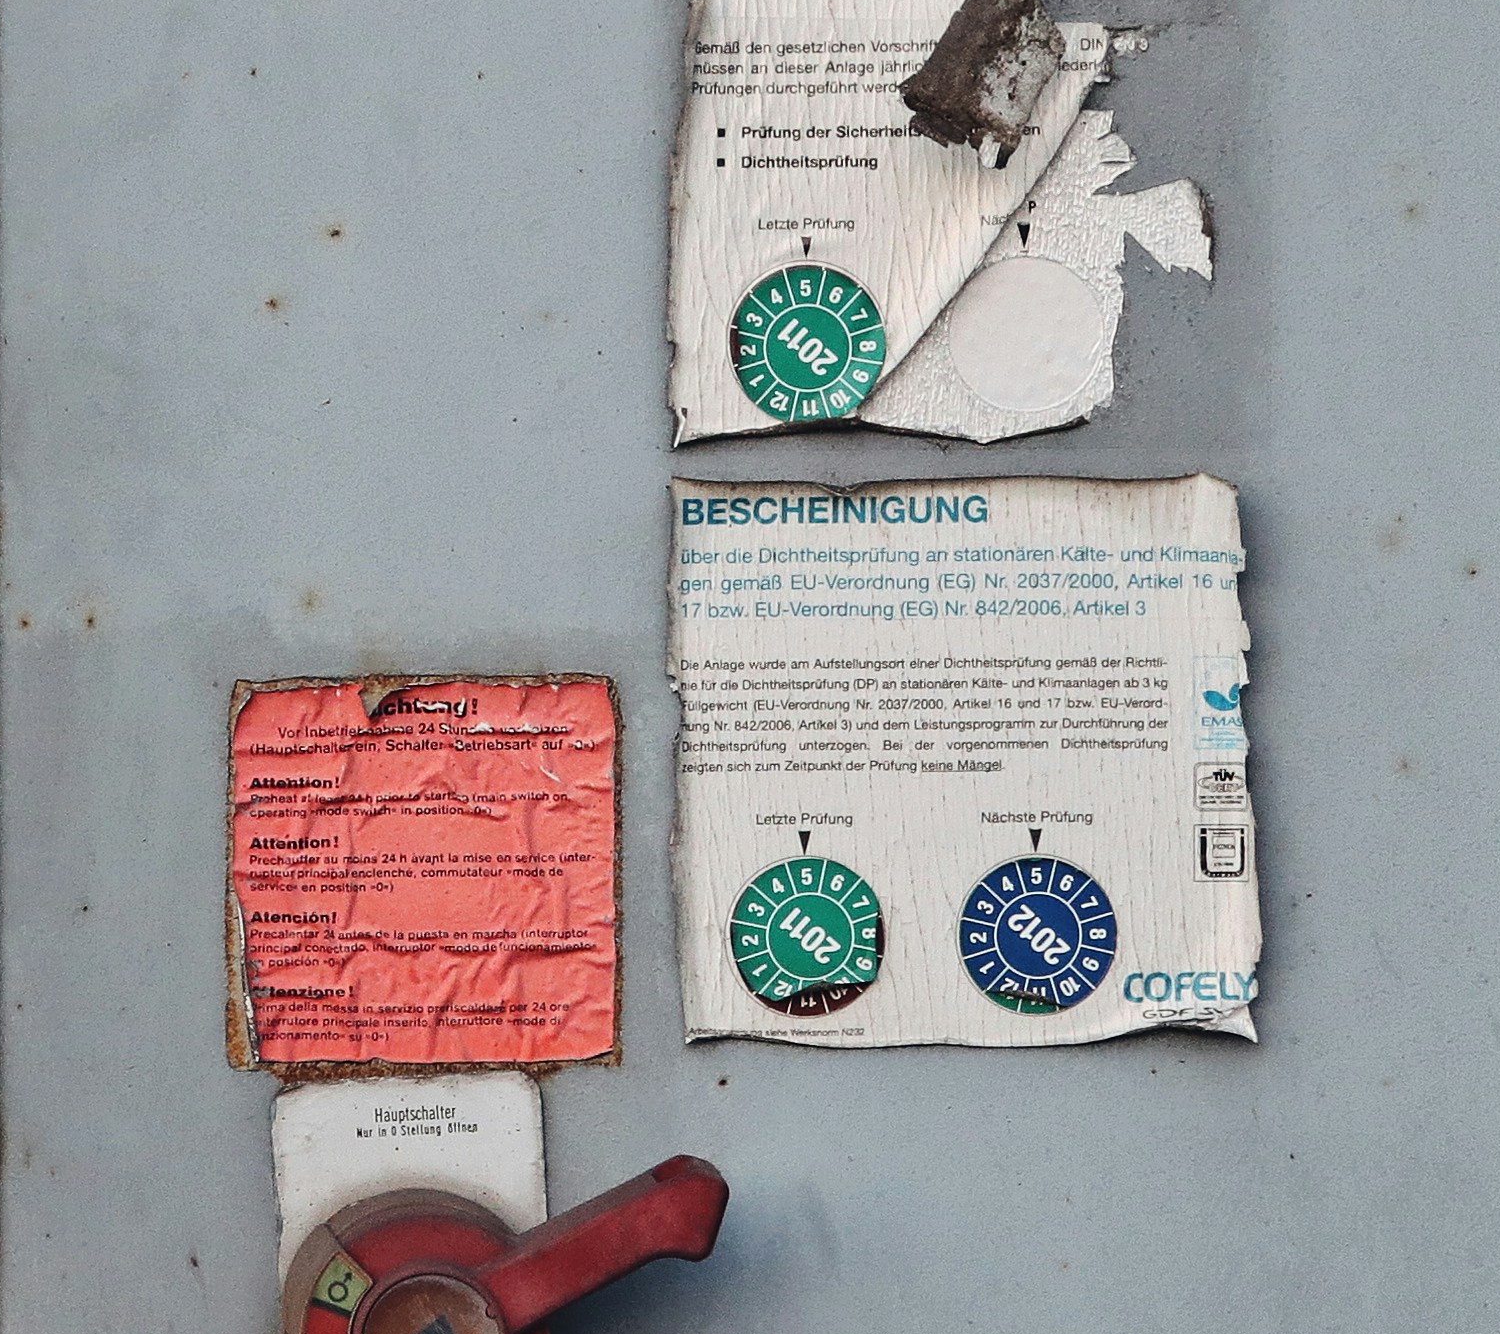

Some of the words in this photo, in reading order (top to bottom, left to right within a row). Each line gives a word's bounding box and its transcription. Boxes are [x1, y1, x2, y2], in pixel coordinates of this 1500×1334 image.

[695, 40, 740, 55] Gemäß
[746, 40, 771, 54] den
[776, 41, 866, 58] gesetzlichen
[693, 62, 744, 75] müssen
[750, 64, 768, 74] an
[774, 61, 817, 75] dieser
[824, 61, 875, 77] Anlage
[692, 82, 761, 98] Prüfungen
[765, 81, 857, 97] durchgeführt
[862, 82, 904, 94] werd
[741, 125, 803, 141] Prüfung
[805, 124, 832, 139] der
[741, 154, 878, 170] Dichtheitsprüfung
[758, 218, 799, 230] Letzte
[802, 217, 855, 231] Prüfung
[777, 318, 839, 376] 2011
[681, 495, 989, 525] BESCHEINIGUNG
[681, 548, 719, 564] über
[726, 549, 753, 563] die
[759, 547, 920, 566] Dichtheitsprüfung
[926, 551, 948, 562] an
[954, 547, 1055, 563] stationären
[1060, 546, 1113, 562] Kälte-
[1120, 547, 1153, 562] und
[1160, 546, 1244, 565] Klimaanla-
[680, 578, 712, 594] gen
[721, 575, 782, 593] gemäß
[791, 574, 929, 593] EU-Verordnung
[938, 572, 976, 593] (EG)
[984, 573, 1007, 589] Nr.
[1017, 573, 1118, 591] 2037/2000,
[1127, 573, 1183, 589] Artikel
[1192, 573, 1213, 589] 16
[1220, 577, 1238, 591] un
[681, 603, 700, 617] 17
[708, 602, 748, 618] bzw.
[755, 601, 893, 620] EU-Verordnung
[900, 600, 938, 619] (EG)
[945, 601, 969, 617] Nr.
[975, 600, 1067, 618] 842/2006,
[1074, 600, 1129, 616] Artikel
[1136, 601, 1146, 616] 3
[680, 660, 699, 671] Die
[703, 660, 745, 672] Anlage
[749, 659, 787, 670] wurde
[790, 661, 810, 670] am
[813, 659, 905, 672] Aufstellungsort
[909, 659, 939, 669] einer
[944, 657, 1051, 670] Dichtheitsprüfung
[1055, 657, 1097, 670] gemäß
[1101, 657, 1121, 668] der
[1126, 657, 1168, 668] Richtli-
[418, 723, 435, 735] 24
[385, 739, 444, 752] Schalter
[541, 739, 563, 750] auf
[681, 741, 787, 754] Dichtheitsprüfung
[798, 741, 870, 753] unterzogen.
[883, 740, 903, 751] Bei
[915, 739, 934, 751] der
[946, 741, 1049, 752] vorgenommenen
[1061, 738, 1168, 751] Dichtheitsprüfung
[250, 777, 340, 789] Attention!
[1212, 769, 1235, 782] TÜV
[755, 814, 796, 825] Letzte
[801, 813, 853, 827] Prüfung
[981, 812, 1036, 824] Nächste
[1041, 811, 1093, 825] Prüfung
[249, 836, 339, 850] Attention!
[343, 855, 378, 865] moins
[381, 853, 396, 863] 24
[400, 854, 407, 863] h
[449, 853, 458, 863] la
[463, 854, 492, 863] mise
[496, 855, 512, 863] en
[559, 852, 595, 863] (inter-
[421, 867, 503, 878] commutateur
[250, 911, 337, 924] Atención!
[779, 907, 842, 964] 2011
[1008, 904, 1071, 965] 2012
[1123, 971, 1256, 1003] COFELY
[374, 1105, 456, 1124] Hauptschalter
[356, 1127, 373, 1138] Nur
[378, 1125, 387, 1137] in
[401, 1124, 441, 1136] Stellung
